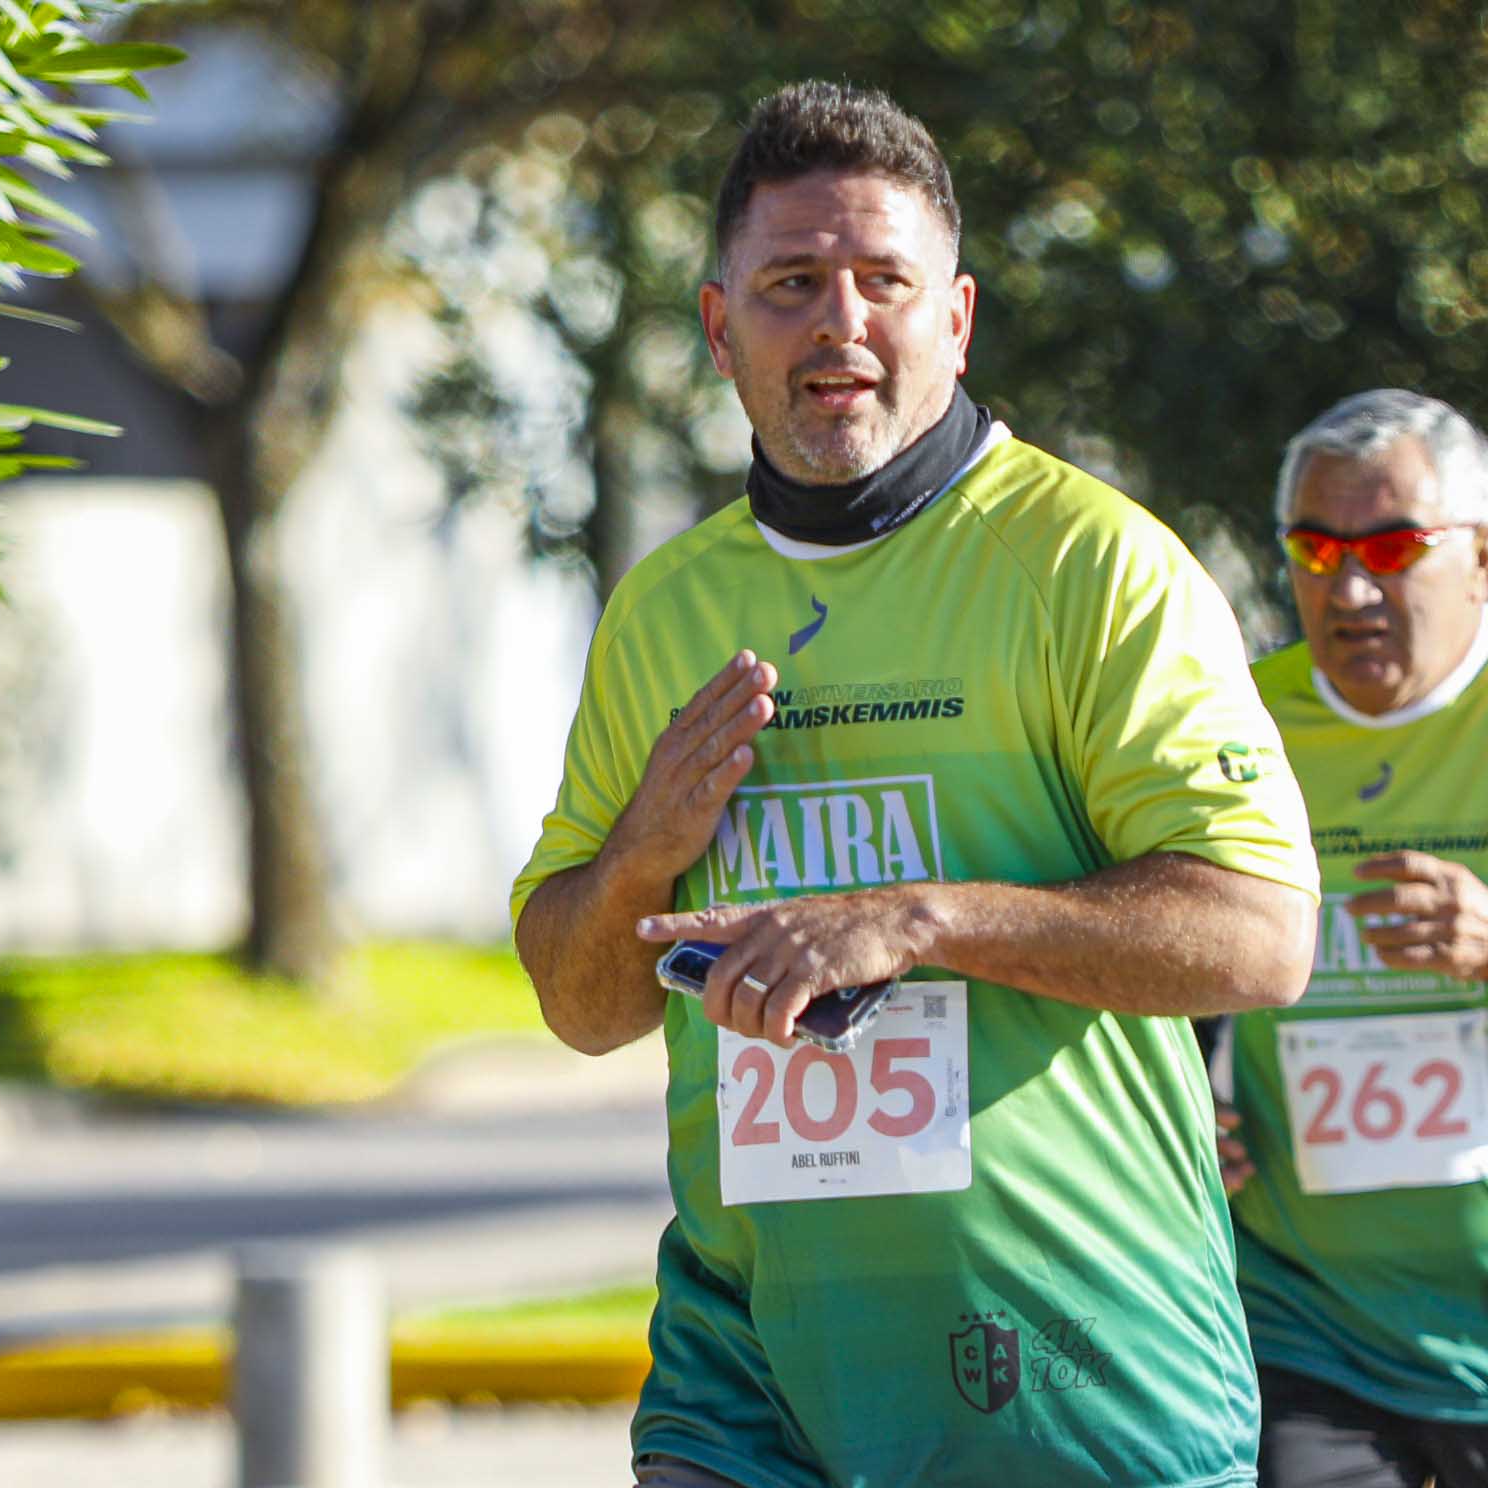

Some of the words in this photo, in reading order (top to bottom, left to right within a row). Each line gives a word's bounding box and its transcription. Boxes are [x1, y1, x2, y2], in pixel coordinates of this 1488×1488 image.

[762, 697, 965, 730] AMSKEMMIS
[717, 791, 929, 895] MAIRA
[731, 1037, 936, 1147] 205
[1301, 1058, 1471, 1145] 262
[792, 1153, 817, 1169] ABEL
[1030, 1352, 1113, 1392] 10K
